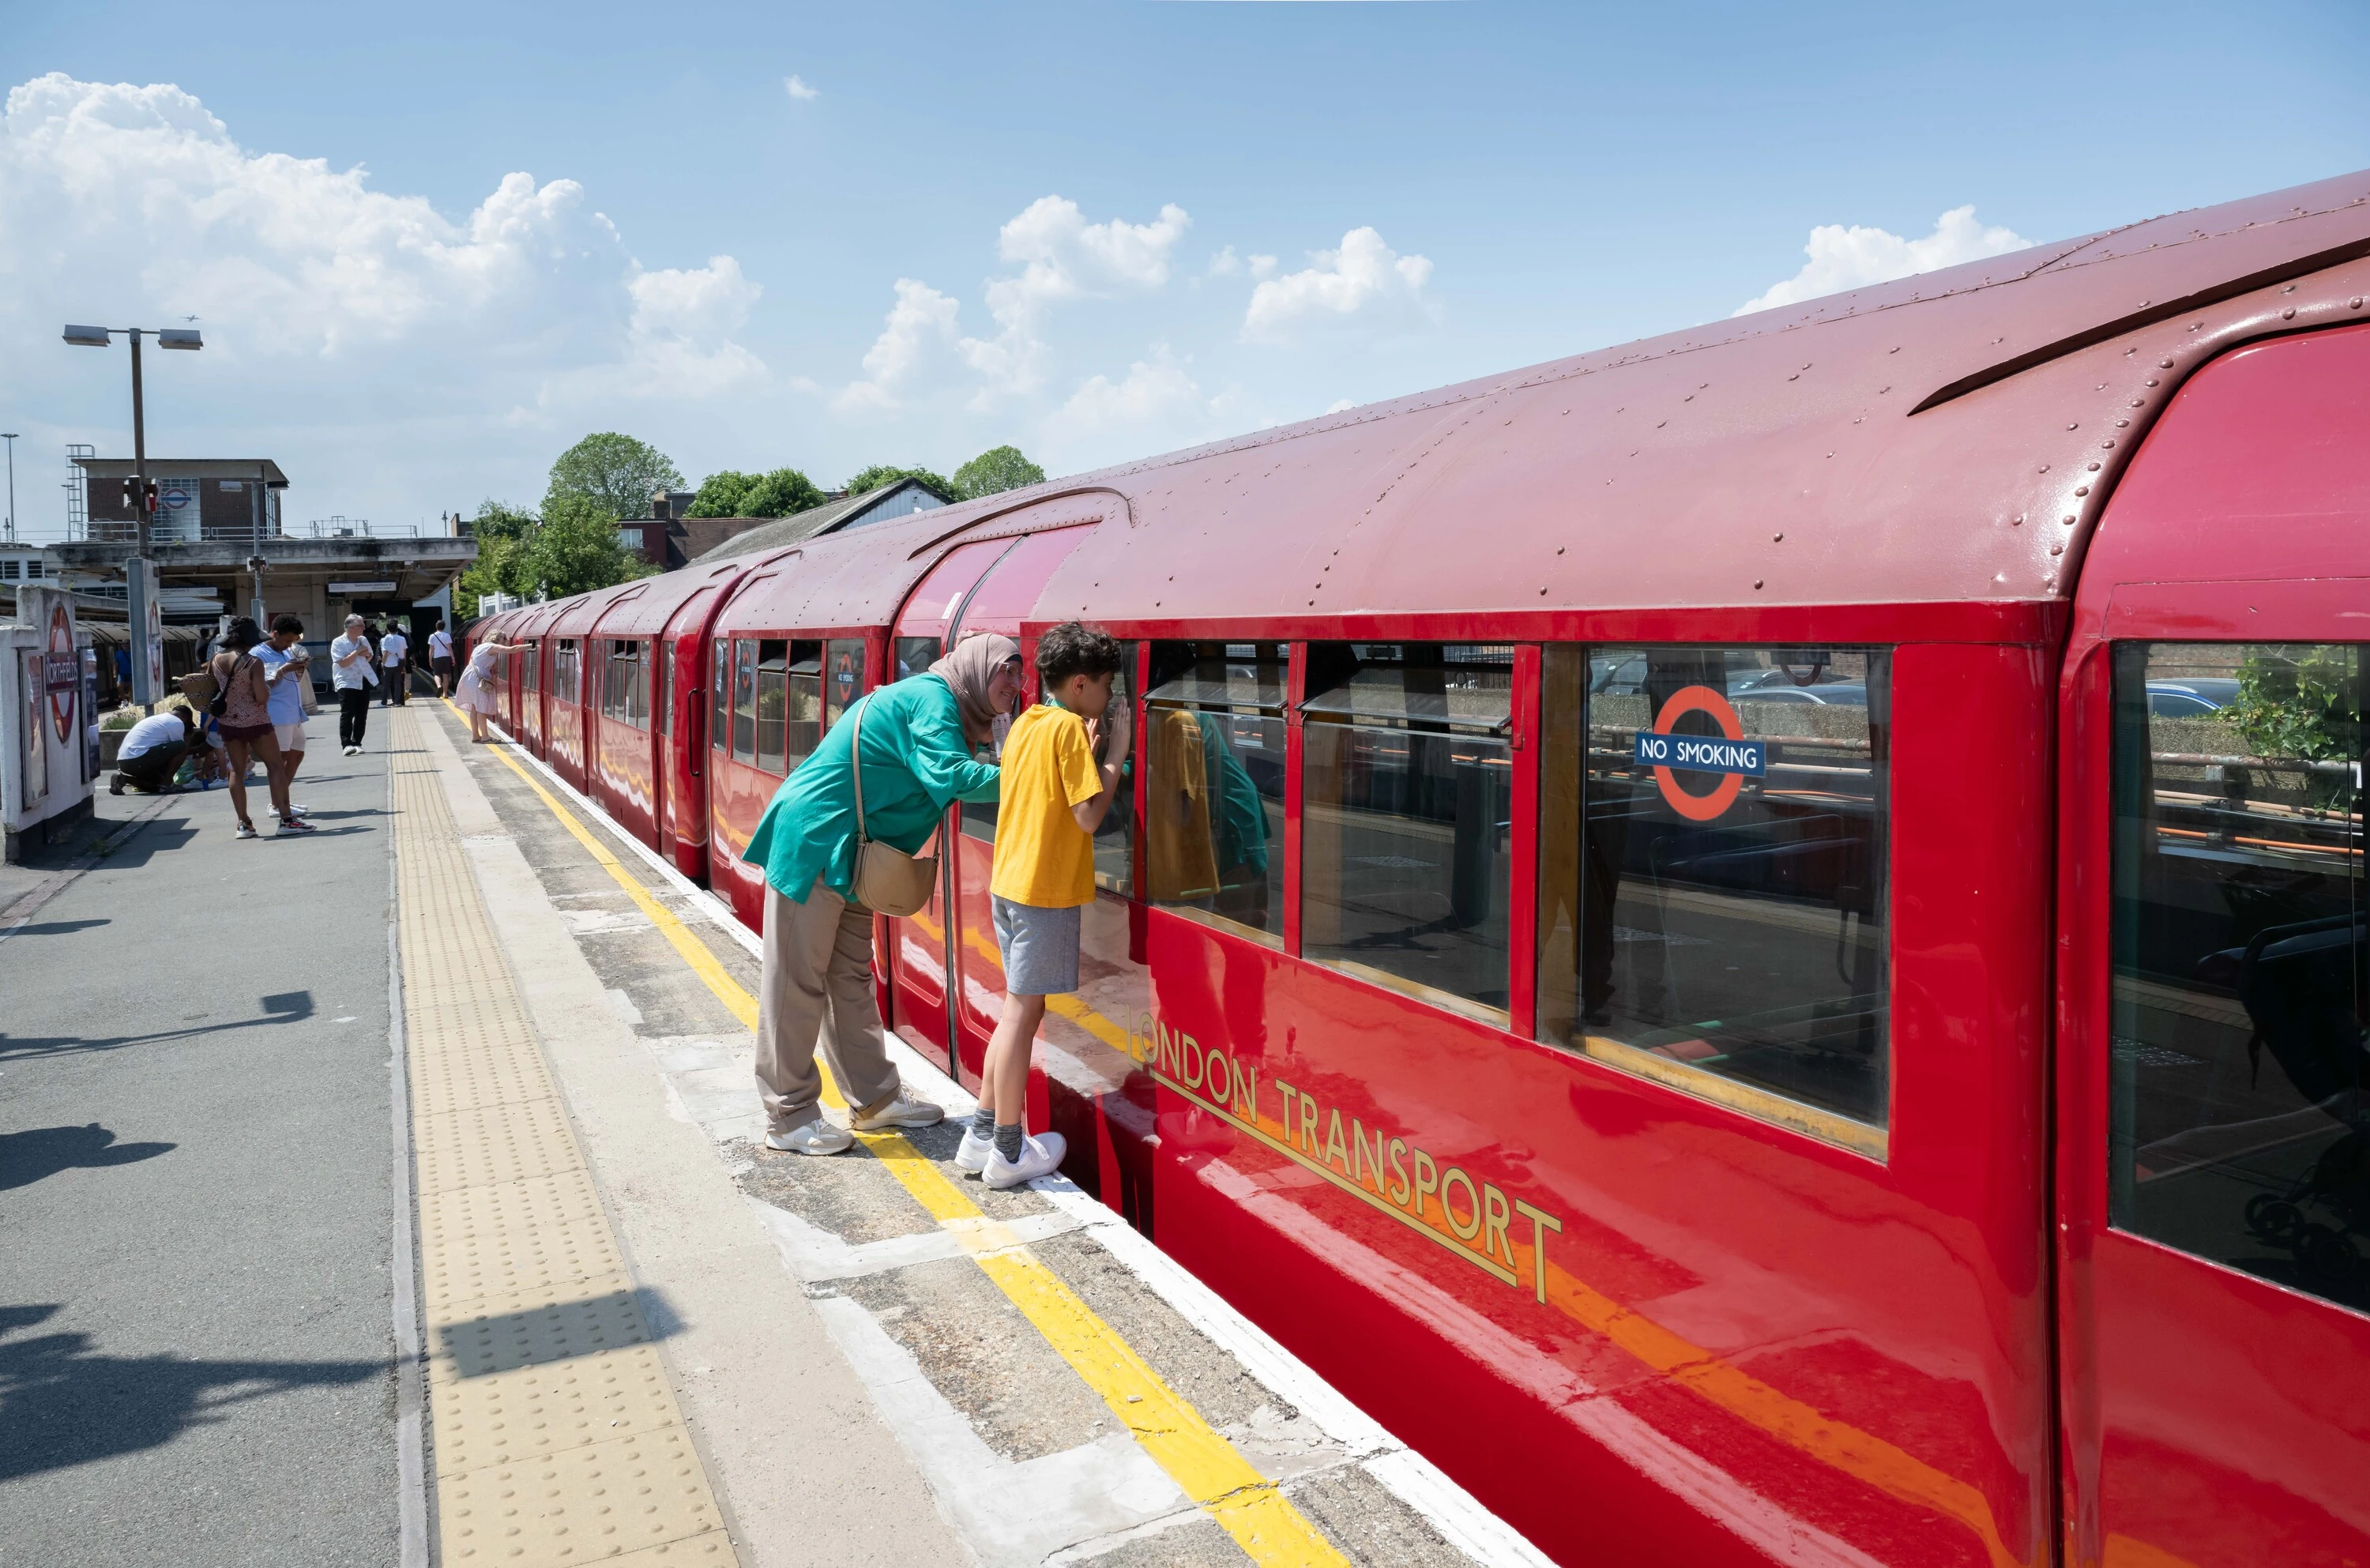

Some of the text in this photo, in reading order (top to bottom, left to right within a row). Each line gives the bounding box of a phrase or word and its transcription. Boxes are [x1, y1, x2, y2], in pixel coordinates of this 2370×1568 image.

[46, 661, 77, 684] NORTHFIELDS
[1642, 739, 1757, 769] NO SMOKING
[1125, 1002, 1563, 1307] LONDON TRANSPORT
